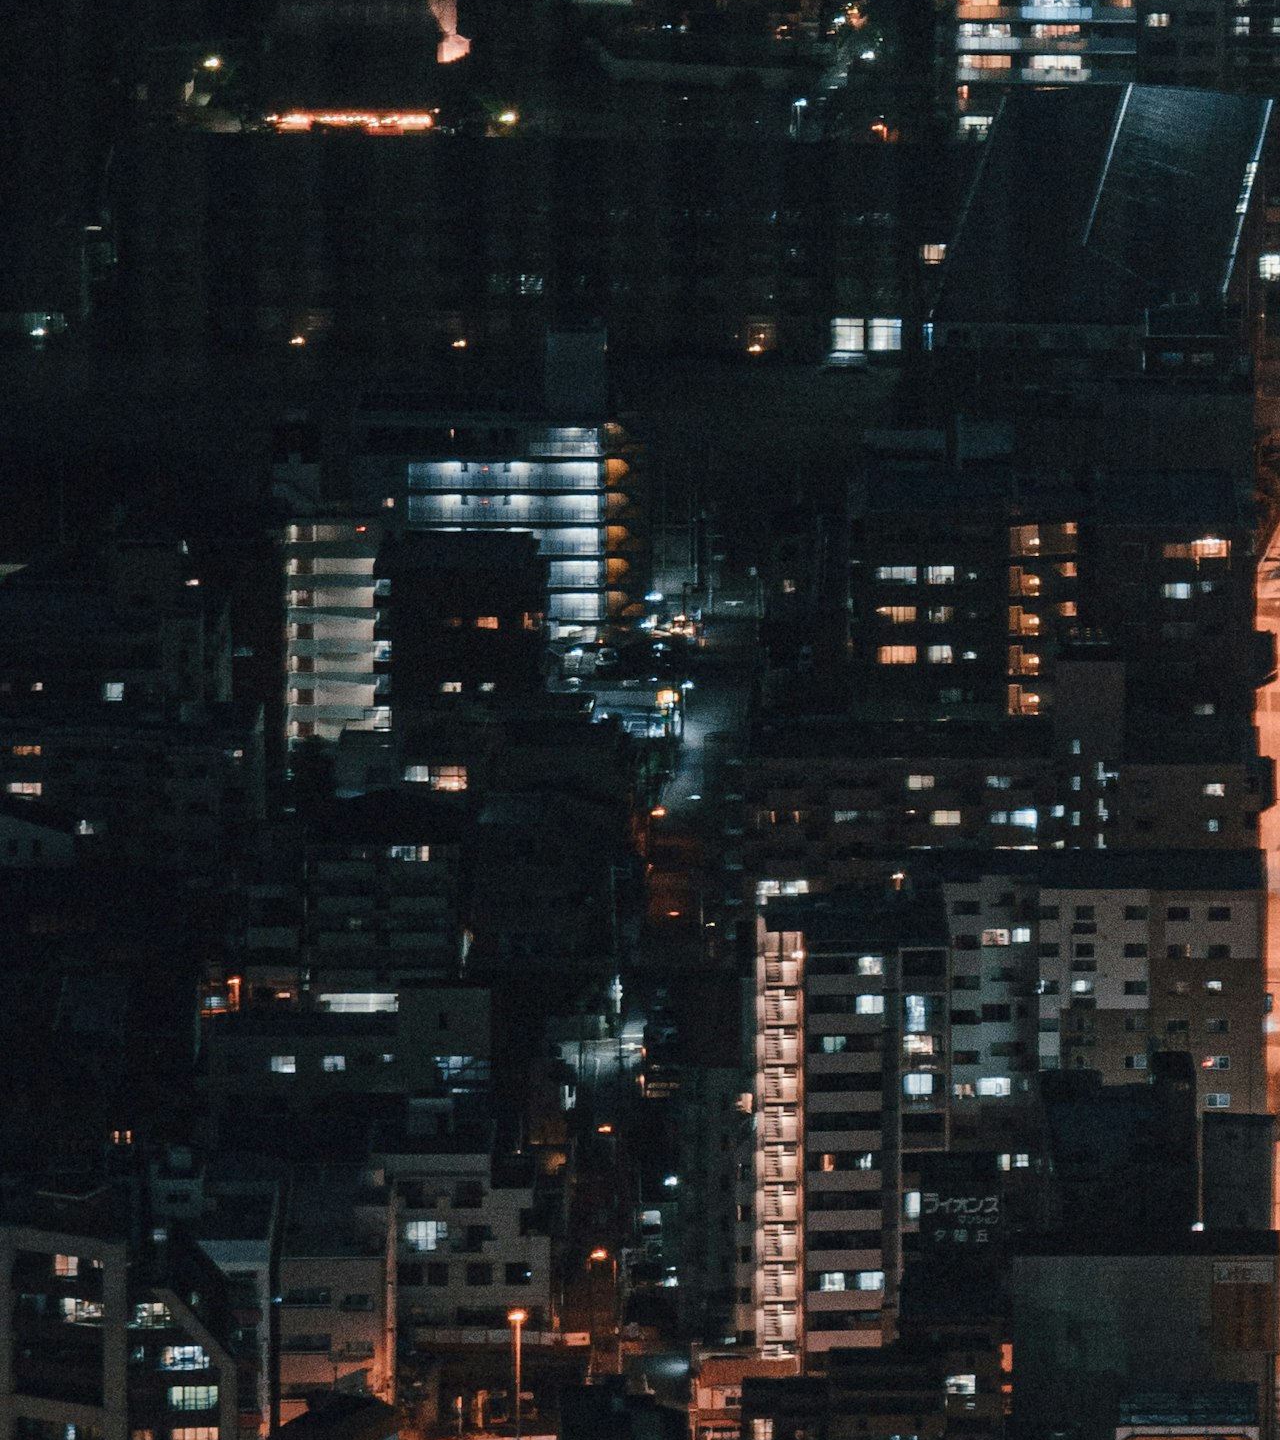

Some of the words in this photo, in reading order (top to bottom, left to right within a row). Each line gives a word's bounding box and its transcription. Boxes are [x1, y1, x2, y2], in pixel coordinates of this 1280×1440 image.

[922, 1192, 999, 1214] ライオンズ
[957, 1215, 999, 1226] マンション
[934, 1230, 989, 1243] 夕陽丘
